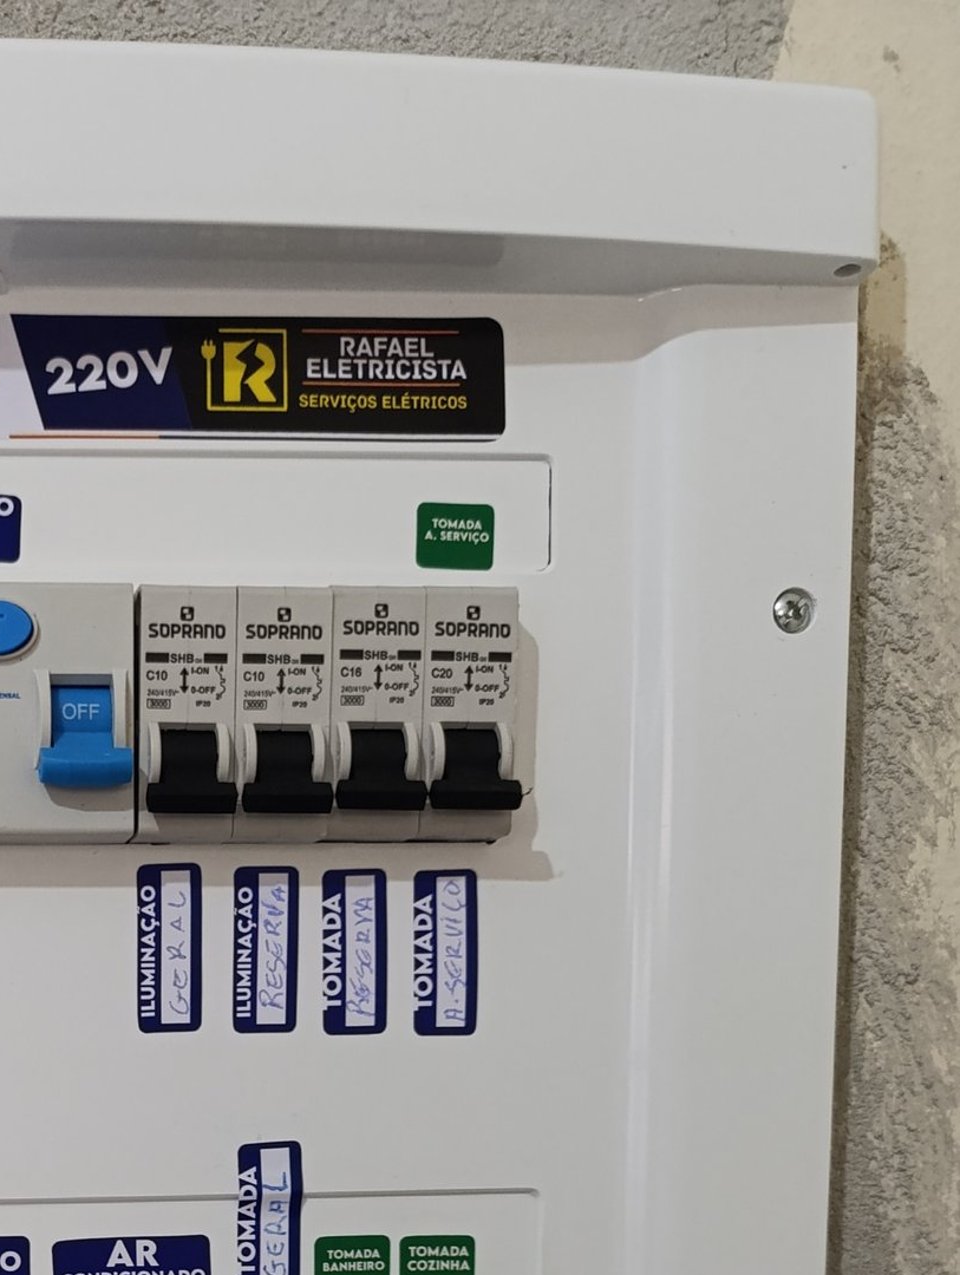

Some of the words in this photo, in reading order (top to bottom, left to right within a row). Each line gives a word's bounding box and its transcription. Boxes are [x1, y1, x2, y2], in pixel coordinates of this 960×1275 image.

[340, 337, 434, 358] RAFAEL
[46, 346, 173, 396] 220V
[306, 359, 467, 381] ELETRICISTA
[299, 393, 378, 413] SERVIÇOS
[382, 389, 468, 410] ELÉTRICOS
[431, 518, 483, 531] TOMADA
[425, 531, 438, 541] A.
[440, 531, 490, 545] SERVIÇO
[148, 623, 226, 639] SOPRANO
[245, 624, 322, 640] SOPRANO
[343, 620, 420, 636] SOPRANO
[435, 621, 511, 638] SOPRANO
[146, 670, 168, 681] C10
[243, 671, 265, 682] C10
[341, 667, 362, 678] C16
[431, 668, 453, 679] C20
[62, 702, 101, 720] OFF
[136, 885, 160, 1018] ILUMINAÇÃO
[166, 891, 191, 1016] GERAL
[233, 886, 258, 1018] ILUMINAÇÃO
[322, 893, 343, 1011] TOMADA
[413, 894, 433, 1011] TOMADA
[237, 1166, 258, 1275] TOMADA
[106, 1239, 160, 1268] AR
[326, 1248, 382, 1260] TOMADA
[407, 1245, 470, 1258] TOMADA
[322, 1260, 385, 1273] BANHEIRO
[406, 1259, 471, 1272] COZINHA
